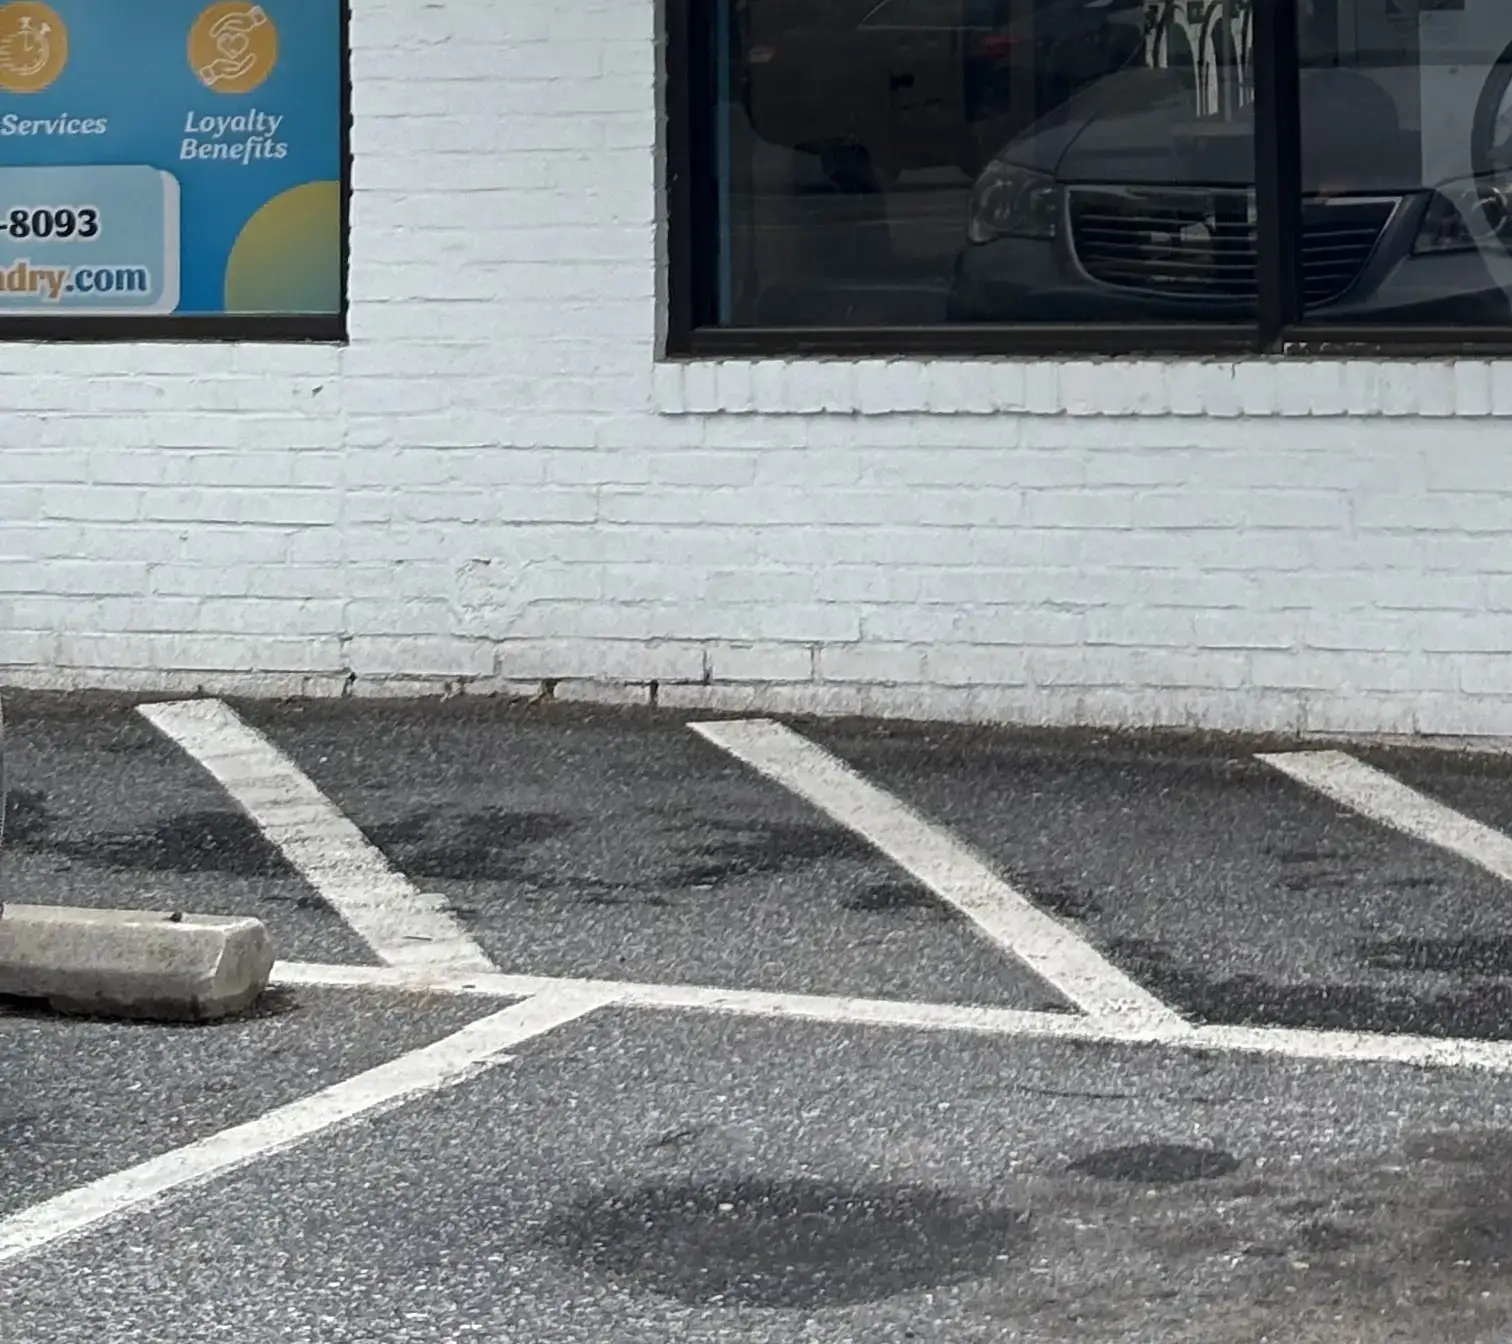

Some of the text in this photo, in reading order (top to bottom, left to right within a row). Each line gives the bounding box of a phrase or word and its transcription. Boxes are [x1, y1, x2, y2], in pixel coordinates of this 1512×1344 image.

[0, 113, 108, 136] Services
[184, 108, 284, 140] Loyalty
[180, 136, 289, 165] Benefits
